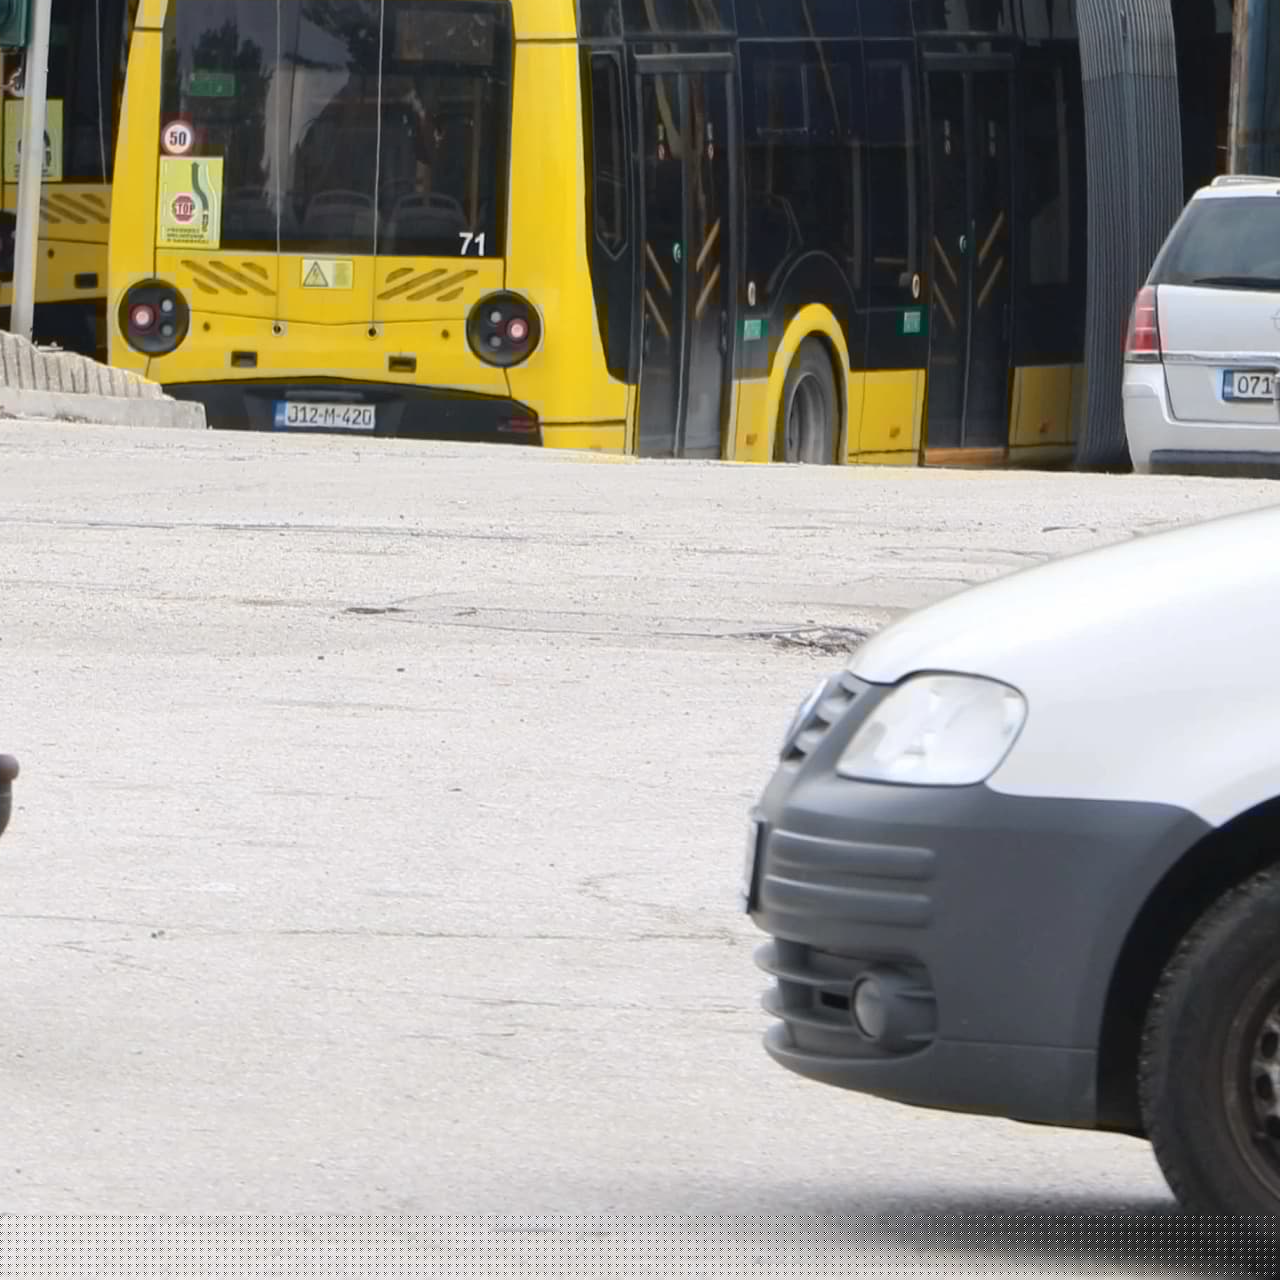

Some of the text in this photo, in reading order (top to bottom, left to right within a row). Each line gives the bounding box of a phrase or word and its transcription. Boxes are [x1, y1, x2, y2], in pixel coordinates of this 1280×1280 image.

[169, 131, 187, 146] 50
[172, 202, 195, 215] STOP
[459, 232, 486, 257] 71
[287, 404, 372, 426] J12-M-420
